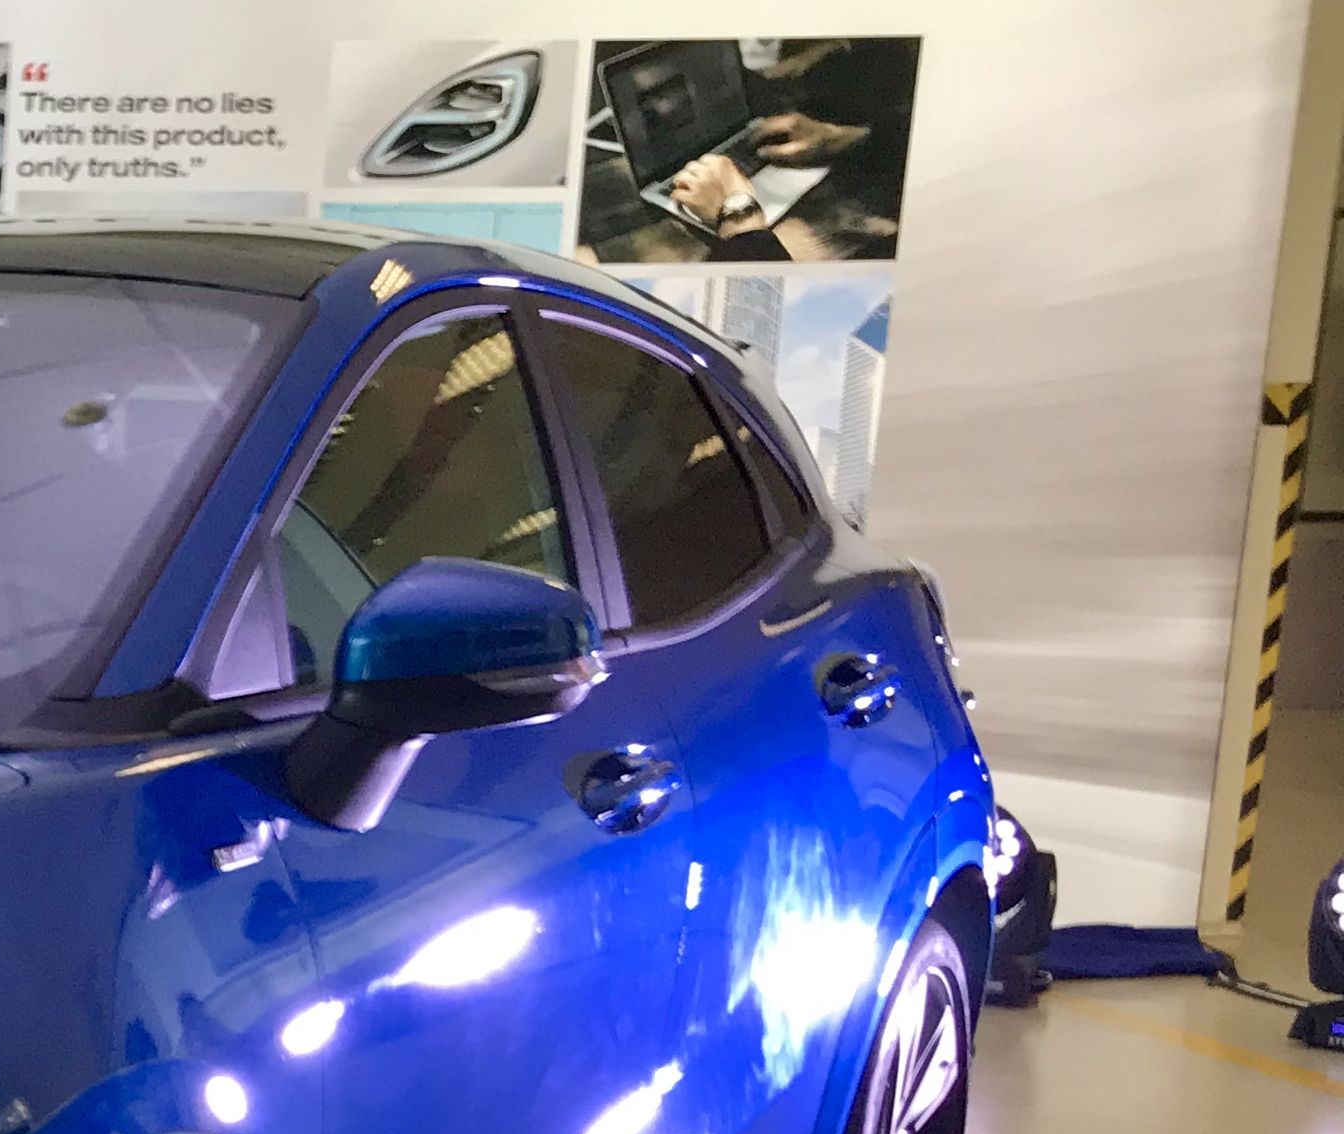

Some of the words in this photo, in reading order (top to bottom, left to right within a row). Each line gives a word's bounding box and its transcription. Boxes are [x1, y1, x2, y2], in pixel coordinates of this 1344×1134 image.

[20, 91, 111, 113] There
[116, 96, 169, 114] are
[175, 96, 215, 114] no
[220, 92, 275, 115] lies
[18, 124, 84, 146] with
[91, 124, 147, 146] this
[153, 125, 286, 150] product,
[16, 157, 81, 182] only
[87, 157, 206, 178] truths.”
